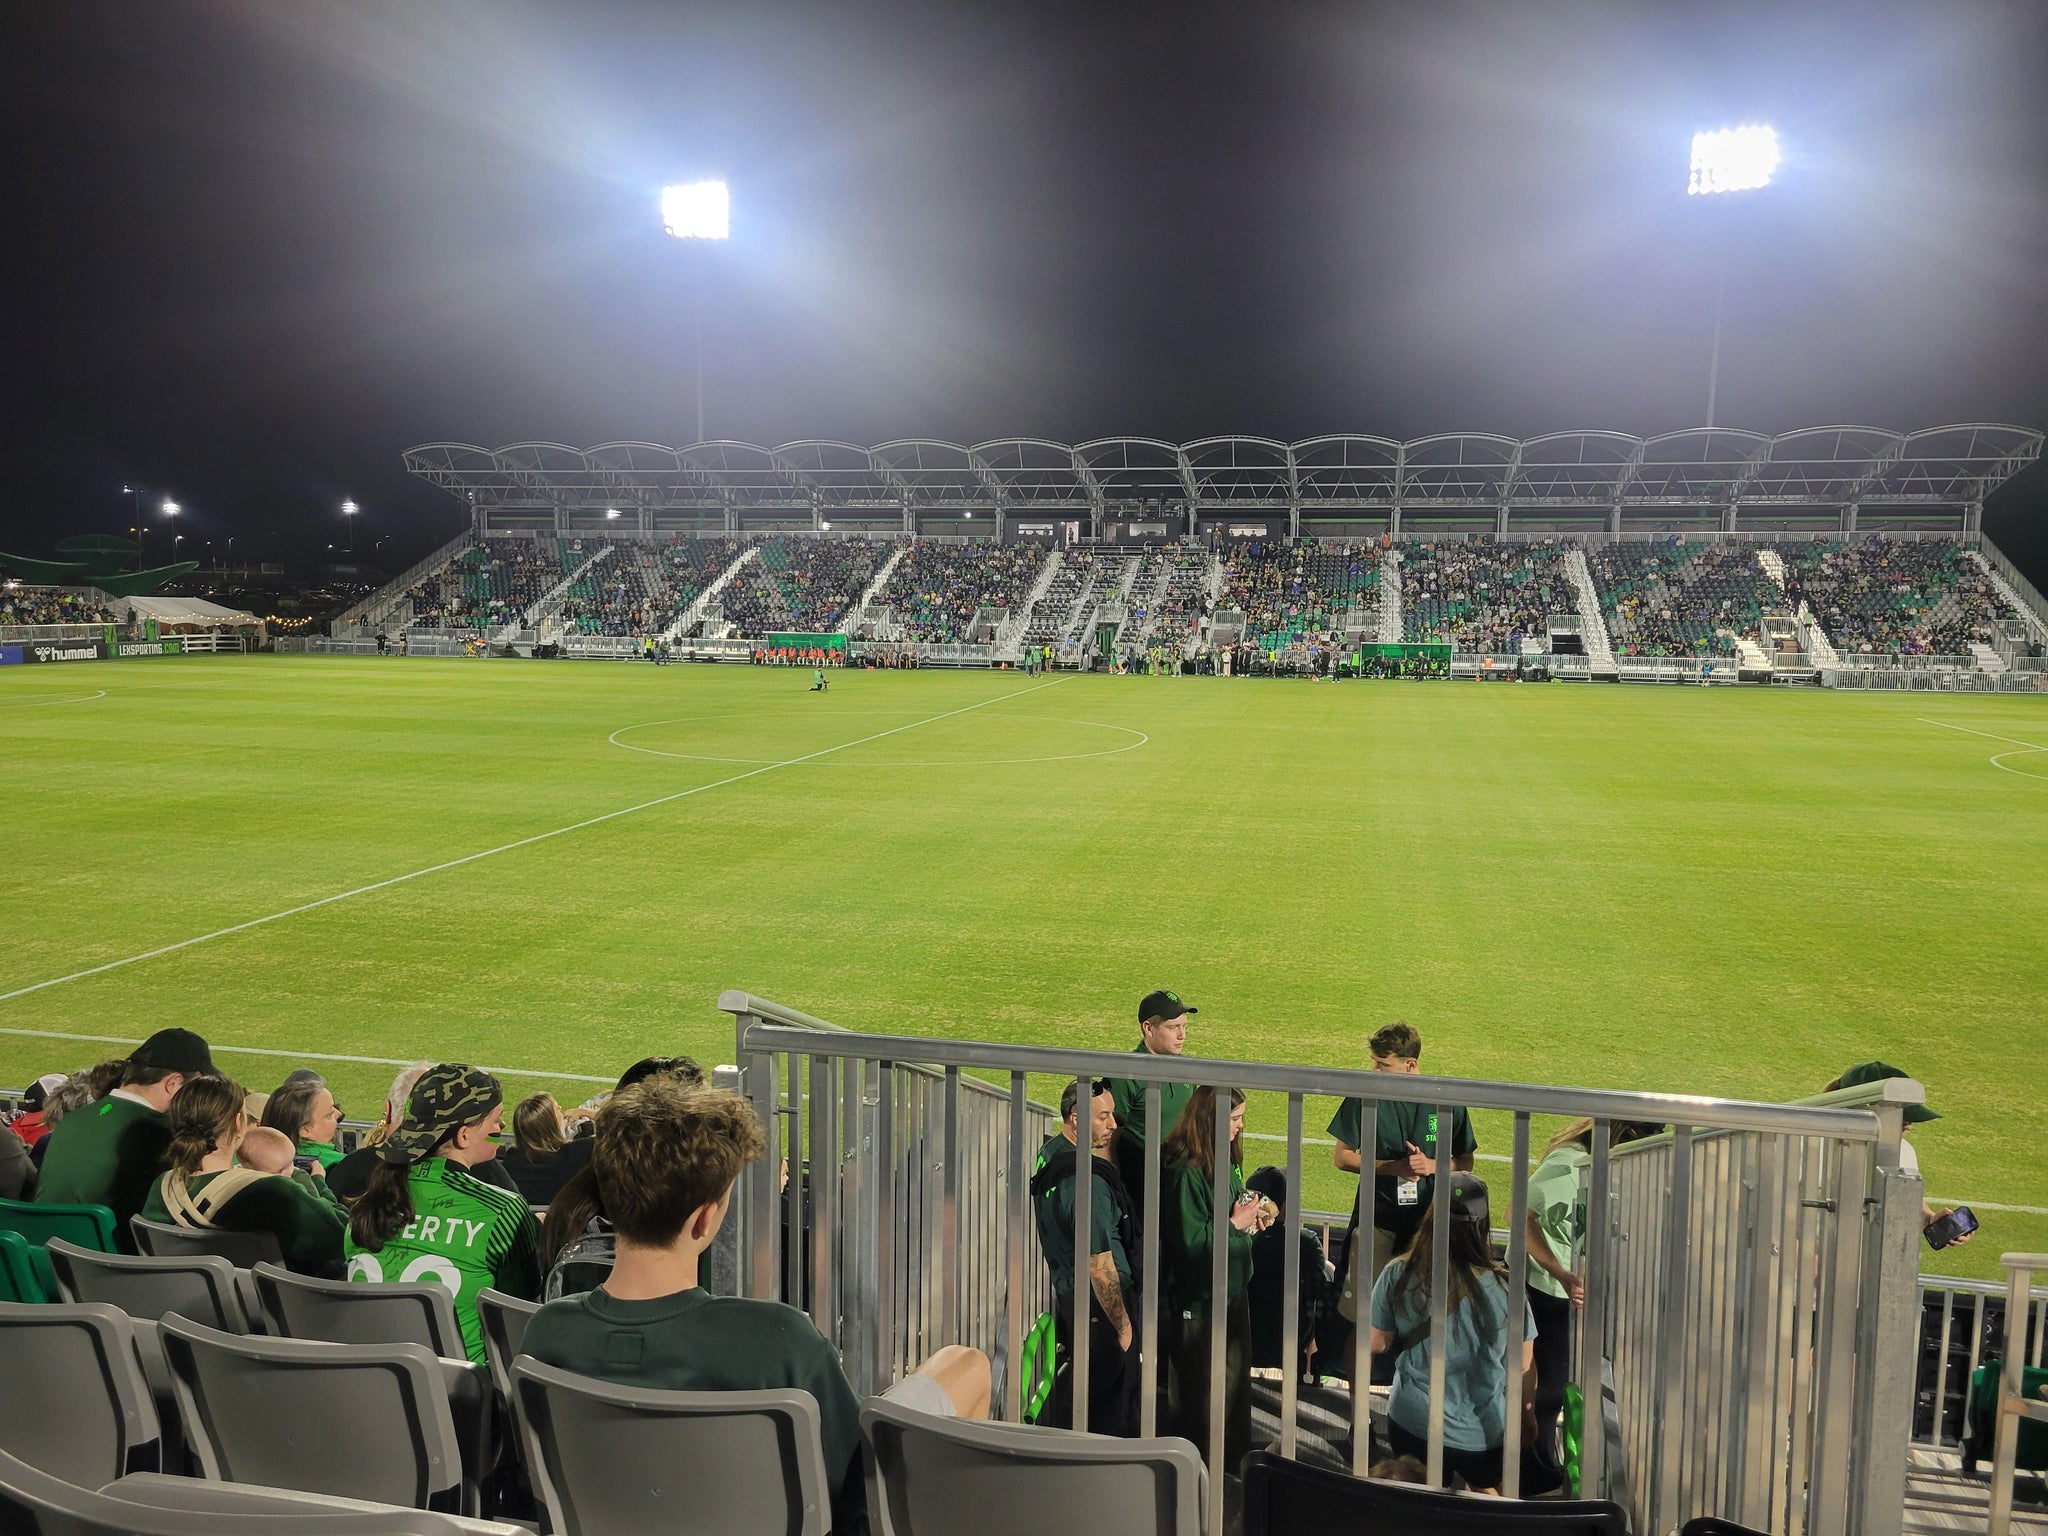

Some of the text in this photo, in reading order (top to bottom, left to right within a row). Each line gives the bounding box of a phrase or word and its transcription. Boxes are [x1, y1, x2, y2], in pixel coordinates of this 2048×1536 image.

[51, 644, 98, 661] hummel
[119, 643, 180, 656] LEXSPORTING.COM
[1425, 1134, 1437, 1142] STA
[401, 1214, 486, 1248] ERTY
